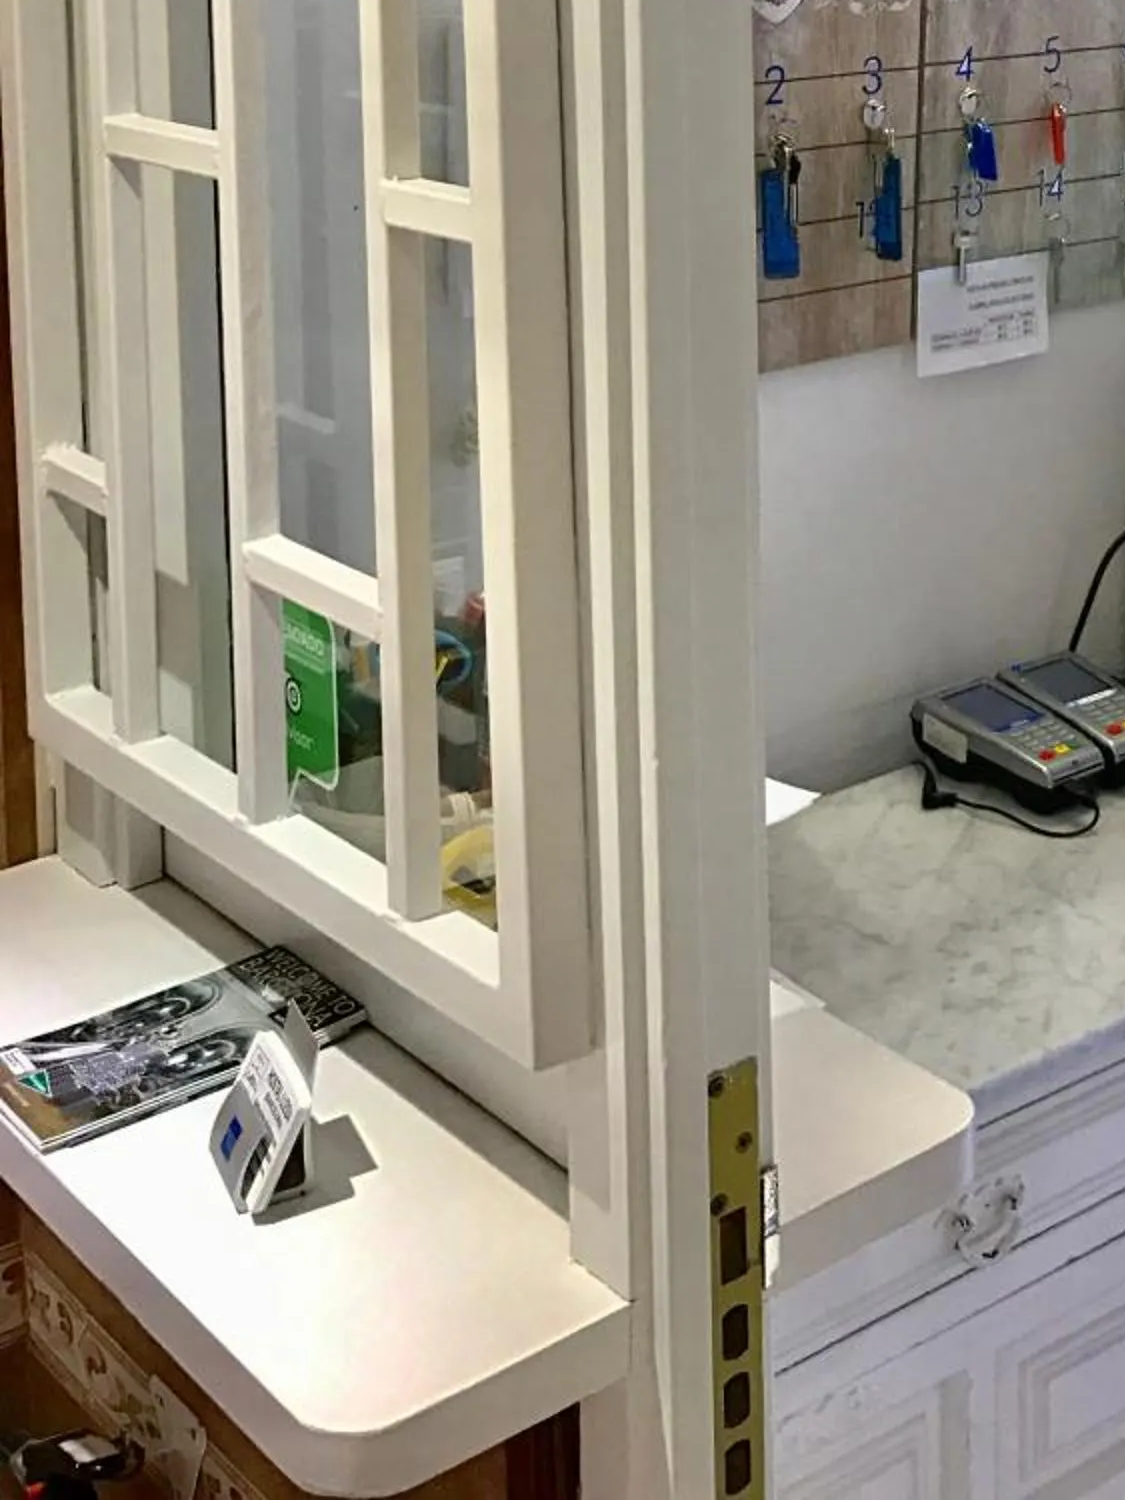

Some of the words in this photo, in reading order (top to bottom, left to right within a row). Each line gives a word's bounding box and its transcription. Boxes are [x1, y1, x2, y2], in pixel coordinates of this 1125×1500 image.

[954, 45, 974, 81] 4
[1043, 35, 1061, 73] 5
[764, 65, 785, 105] 2
[862, 55, 883, 95] 3
[951, 180, 984, 221] 13
[1037, 167, 1065, 207] 14
[331, 994, 356, 1015] TO
